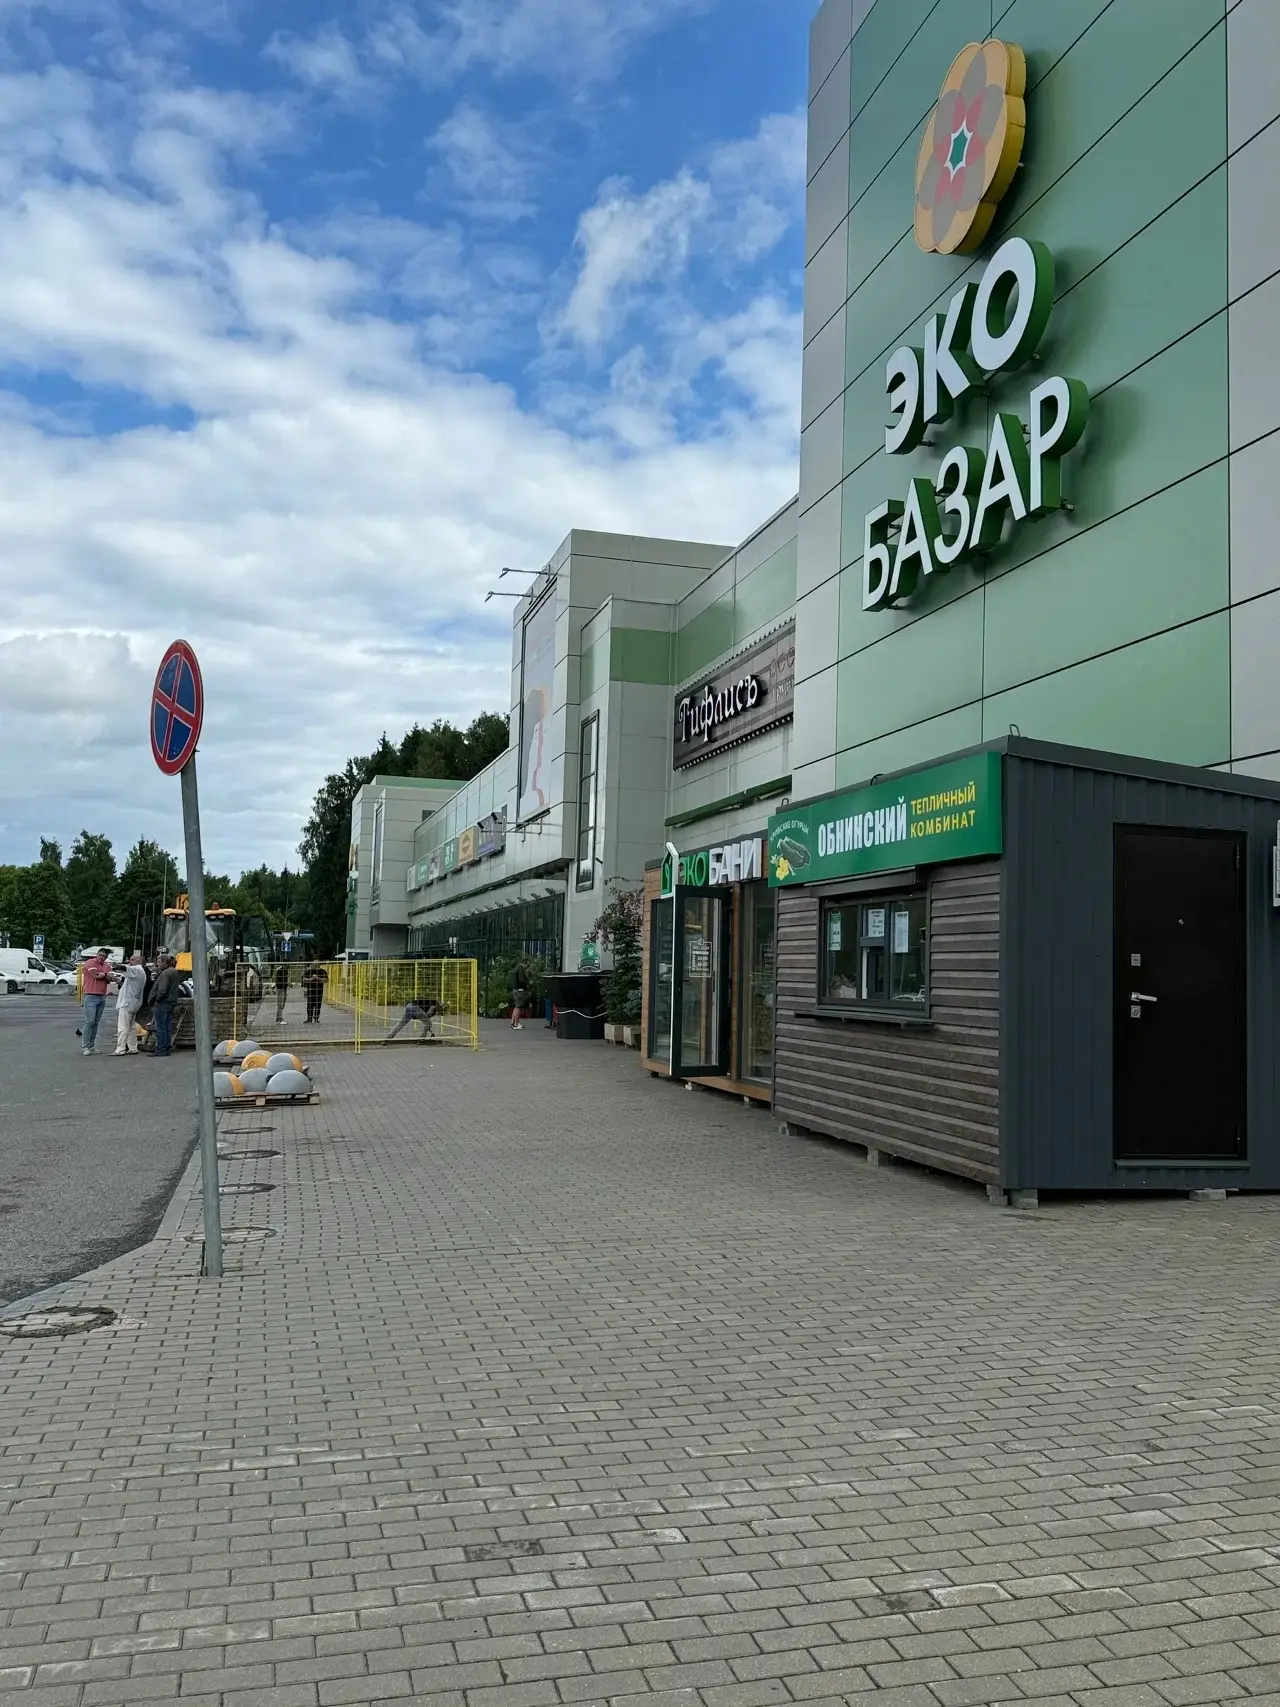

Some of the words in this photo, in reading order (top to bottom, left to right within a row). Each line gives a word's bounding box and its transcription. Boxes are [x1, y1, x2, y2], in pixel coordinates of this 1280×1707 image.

[885, 237, 1038, 453] ЭКО
[863, 376, 1071, 611] БАЗАР
[678, 674, 758, 742] Тифлисъ
[818, 795, 906, 857] ОБНИНСКИЙ
[910, 781, 975, 815] ТЕПЛИЧНЫЙ
[910, 810, 975, 838] КОМБИНАТ
